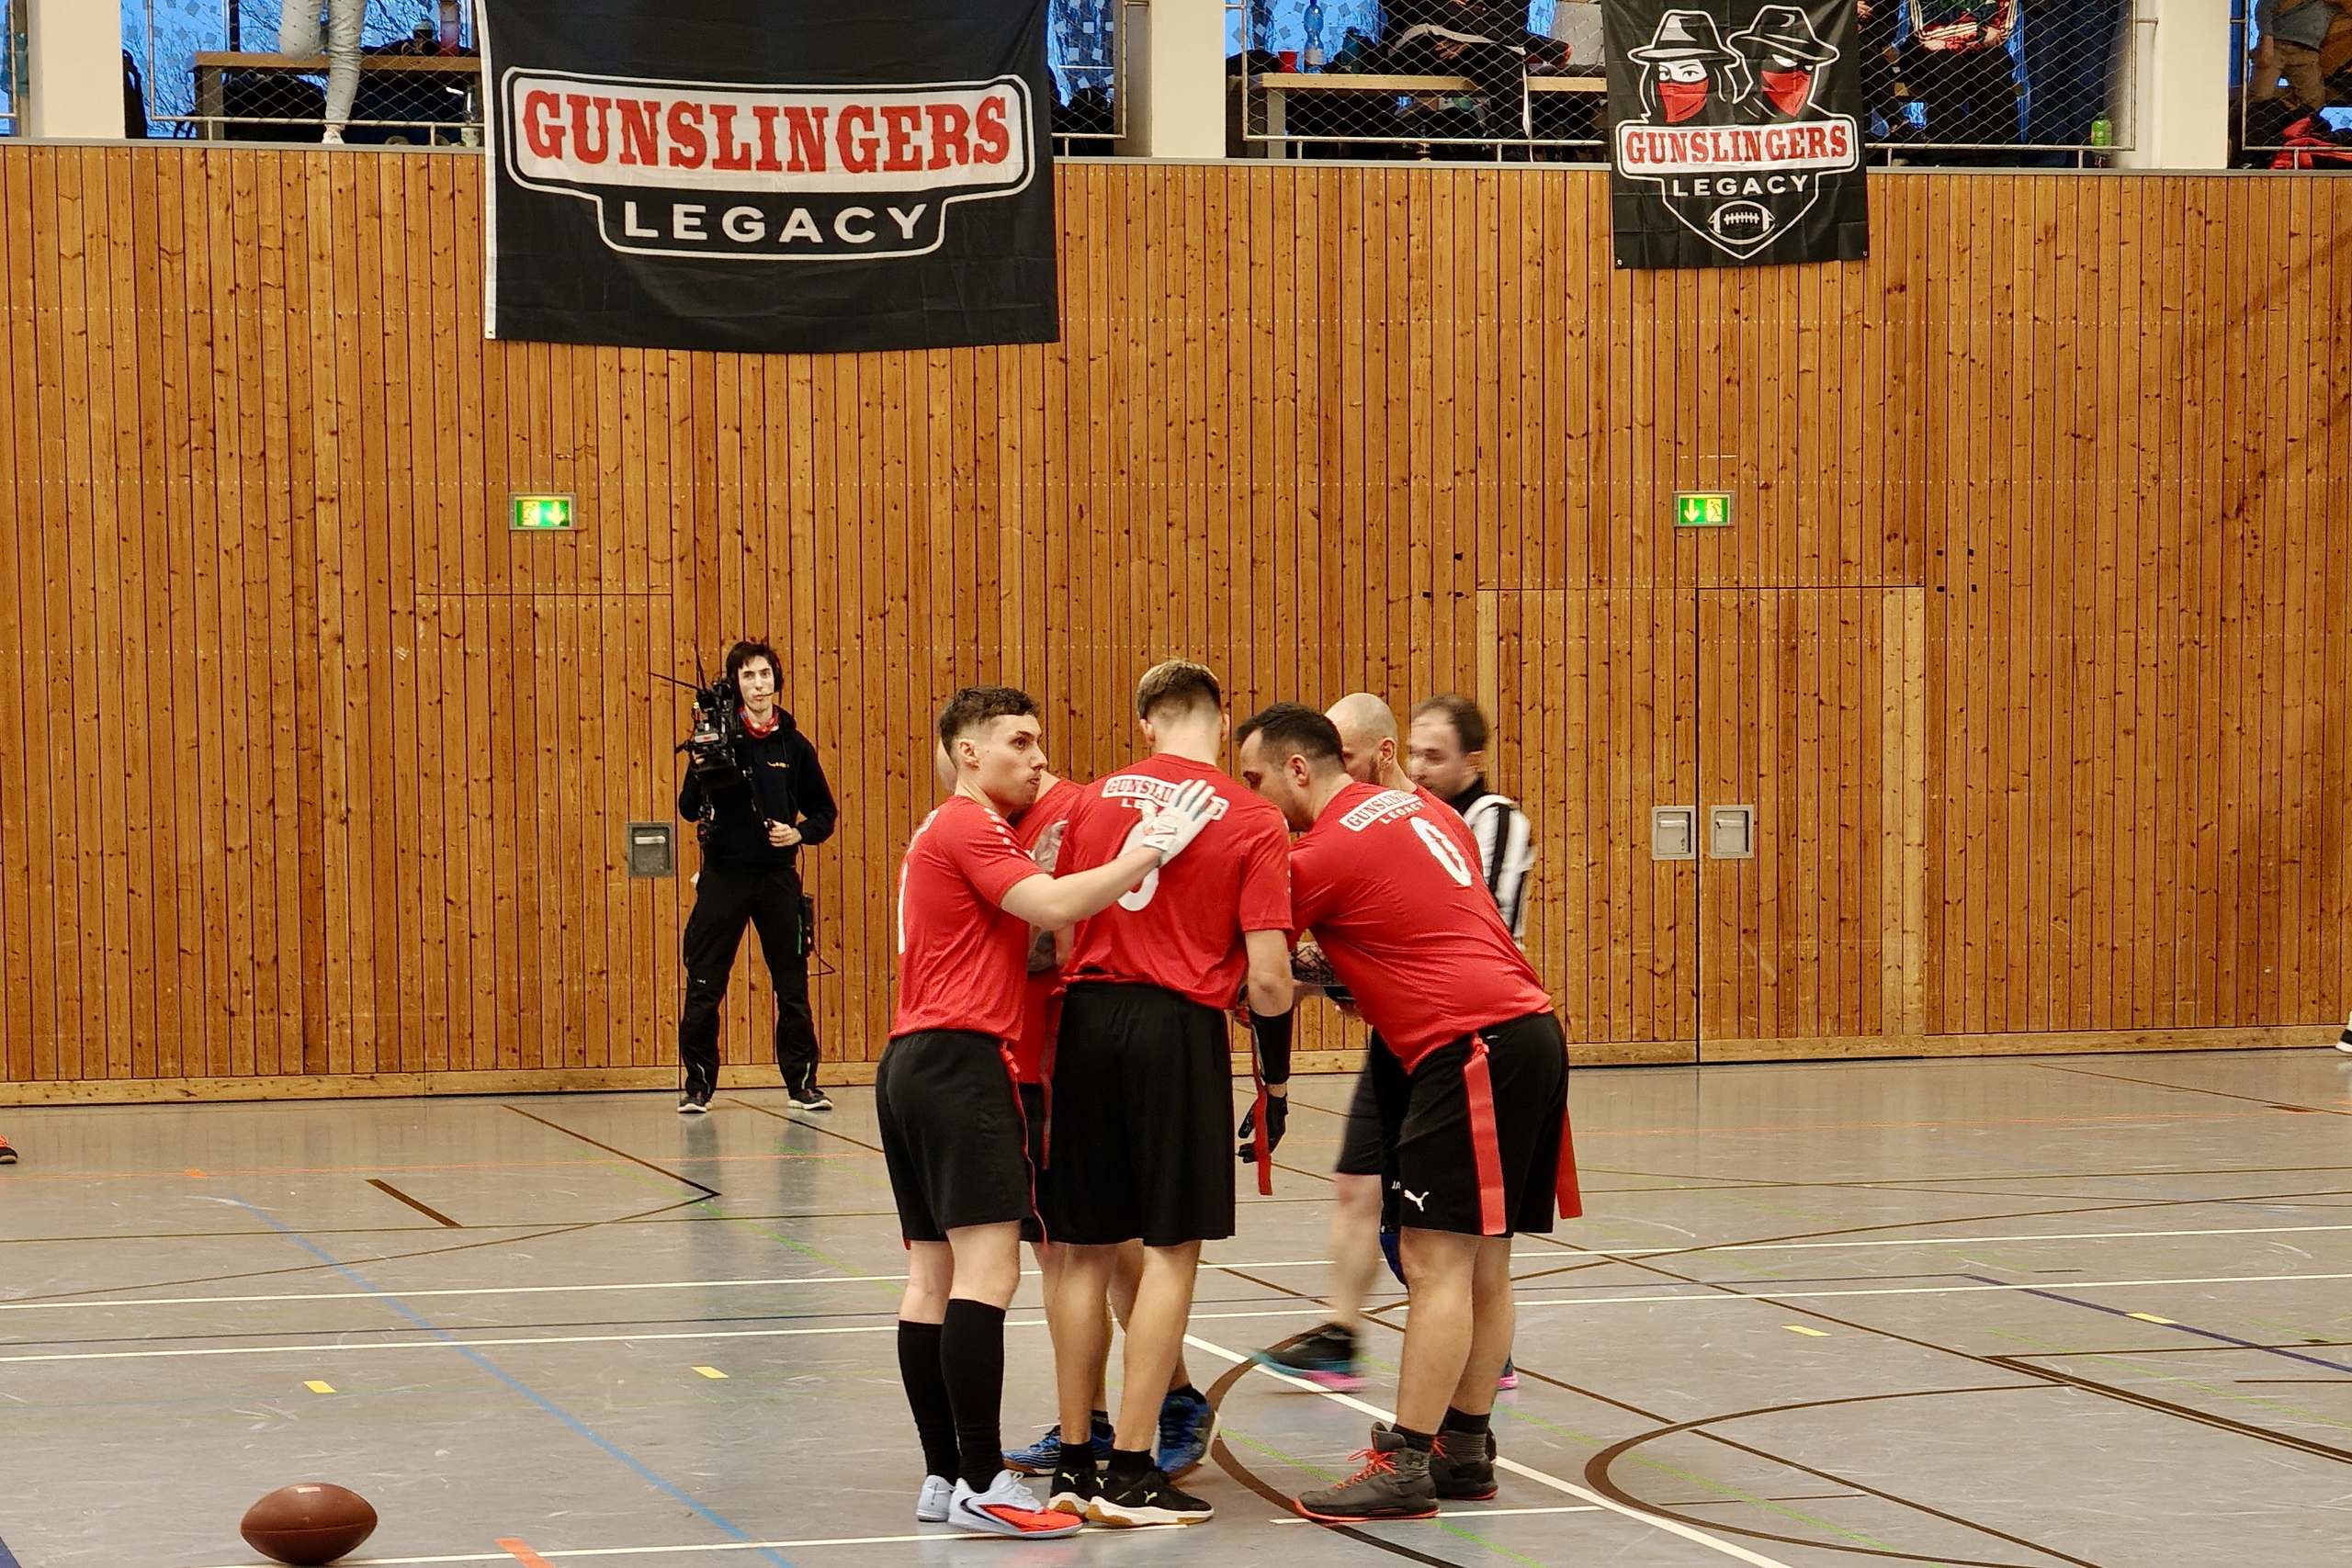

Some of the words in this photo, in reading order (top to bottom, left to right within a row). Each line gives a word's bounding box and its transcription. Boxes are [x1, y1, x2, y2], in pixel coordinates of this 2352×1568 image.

[523, 90, 1010, 174] GUNSLINGERS
[1625, 125, 1848, 164] GUNSLINGERS
[1672, 175, 1809, 197] LEGACY
[625, 201, 927, 243] LEGACY
